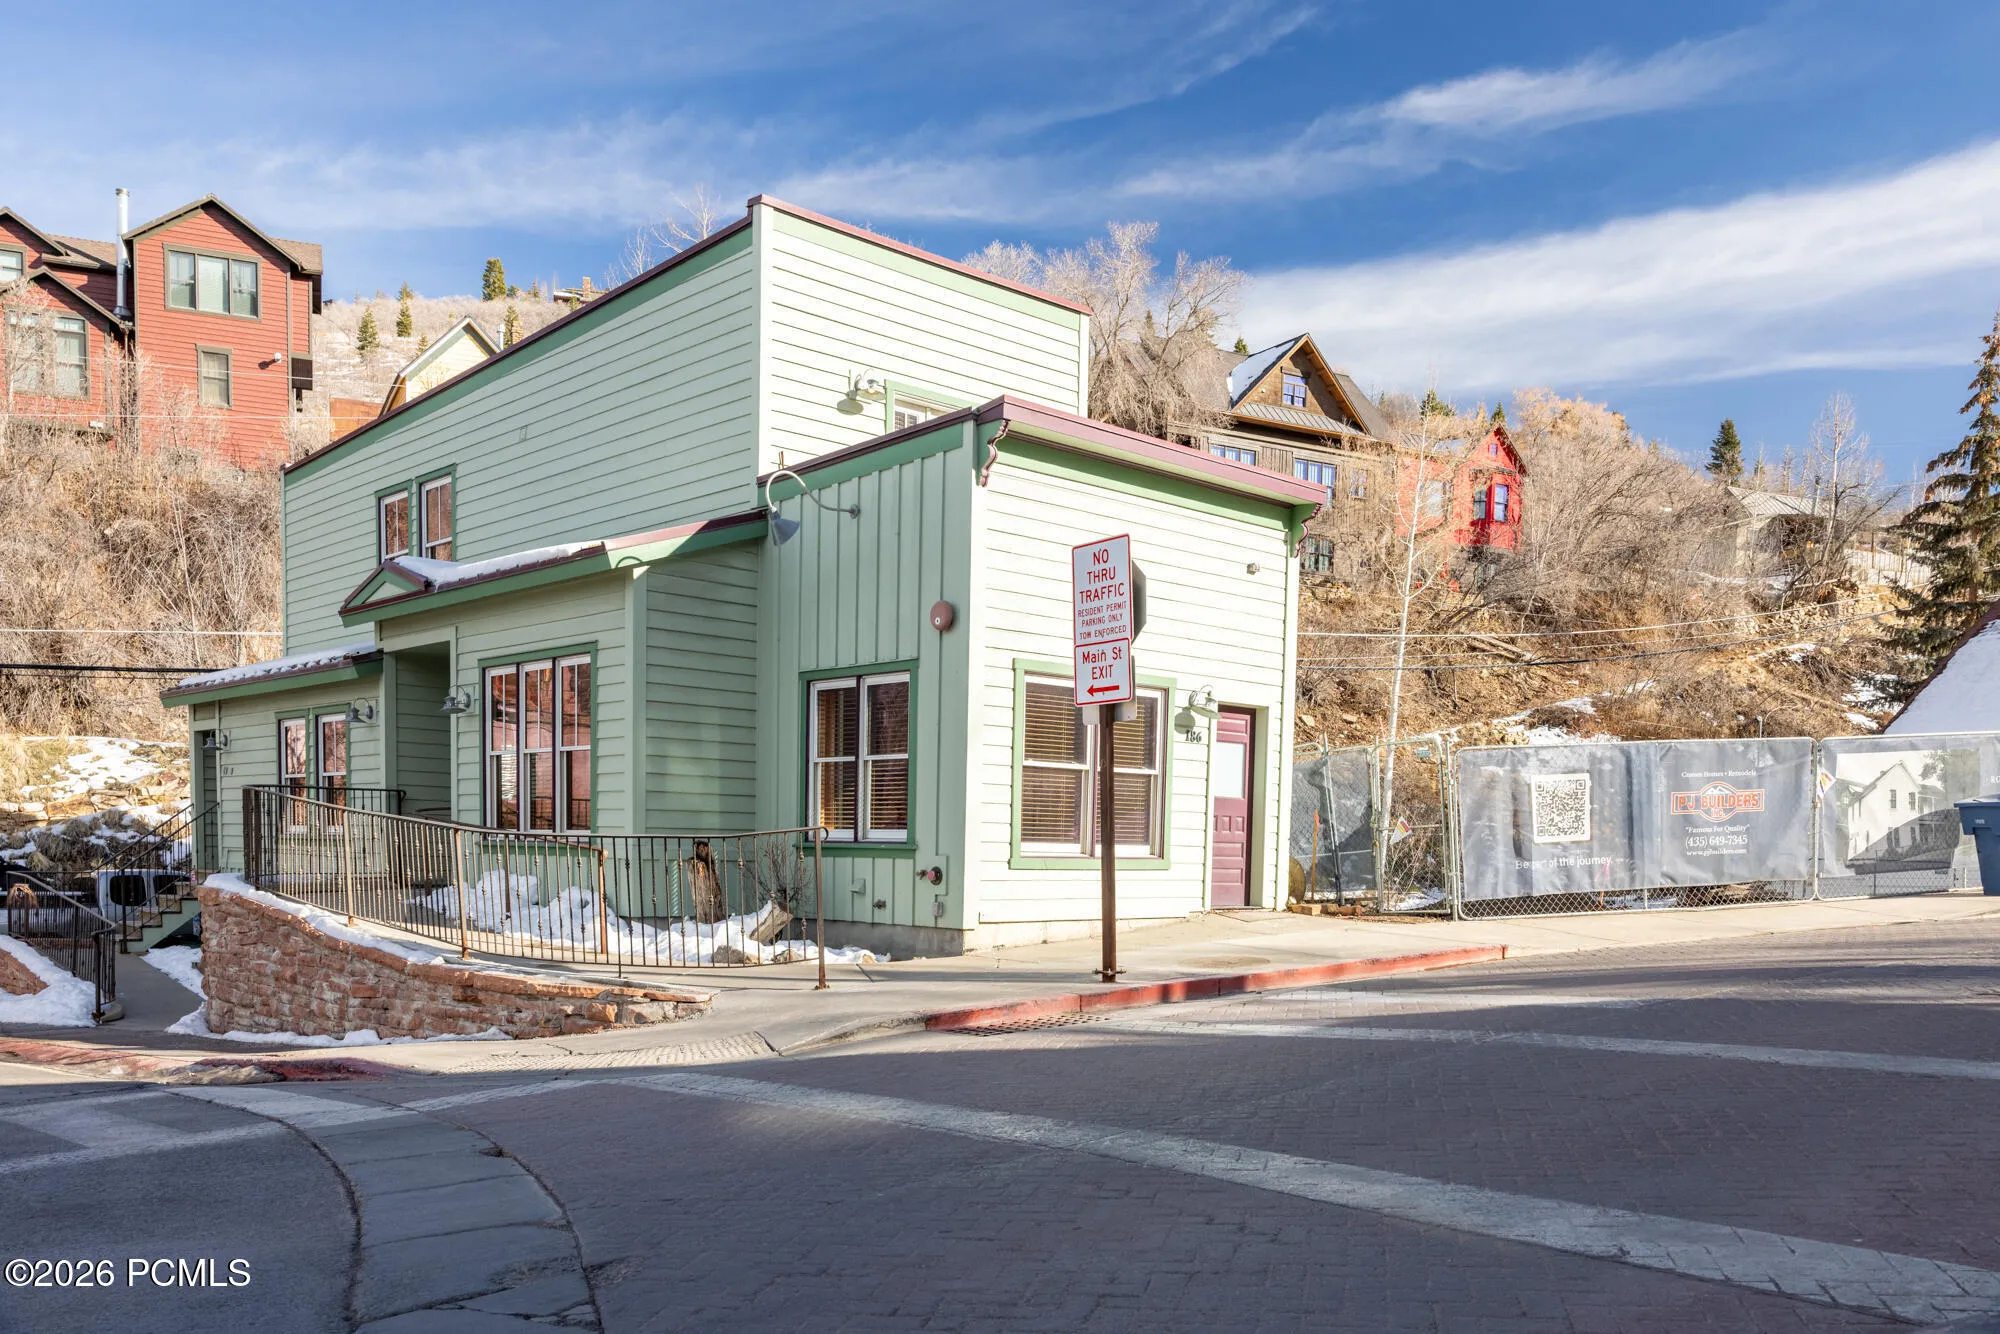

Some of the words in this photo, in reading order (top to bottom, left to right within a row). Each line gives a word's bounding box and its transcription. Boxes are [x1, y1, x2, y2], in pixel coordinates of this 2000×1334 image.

[1093, 548, 1109, 565] NO
[1087, 566, 1116, 585] THRU
[1079, 583, 1125, 604] TRAFFIC
[1078, 605, 1104, 617] RESIDENT
[1106, 601, 1127, 613] PERMIT
[1081, 615, 1106, 627] PARKING
[1108, 613, 1123, 623] ONLY
[1079, 630, 1092, 640] TOW
[1094, 625, 1127, 638] ENFORCED
[1082, 650, 1107, 665] Main
[1112, 647, 1122, 661] St
[1091, 664, 1114, 680] EXIT
[1185, 729, 1202, 742] 186
[1677, 795, 1695, 809] PJ
[1701, 793, 1759, 809] BUILDERS
[1685, 836, 1707, 849] (435)
[1709, 835, 1748, 846] 649-7345
[1515, 860, 1529, 869] Be
[1549, 857, 1557, 868] of
[1560, 857, 1575, 867] the
